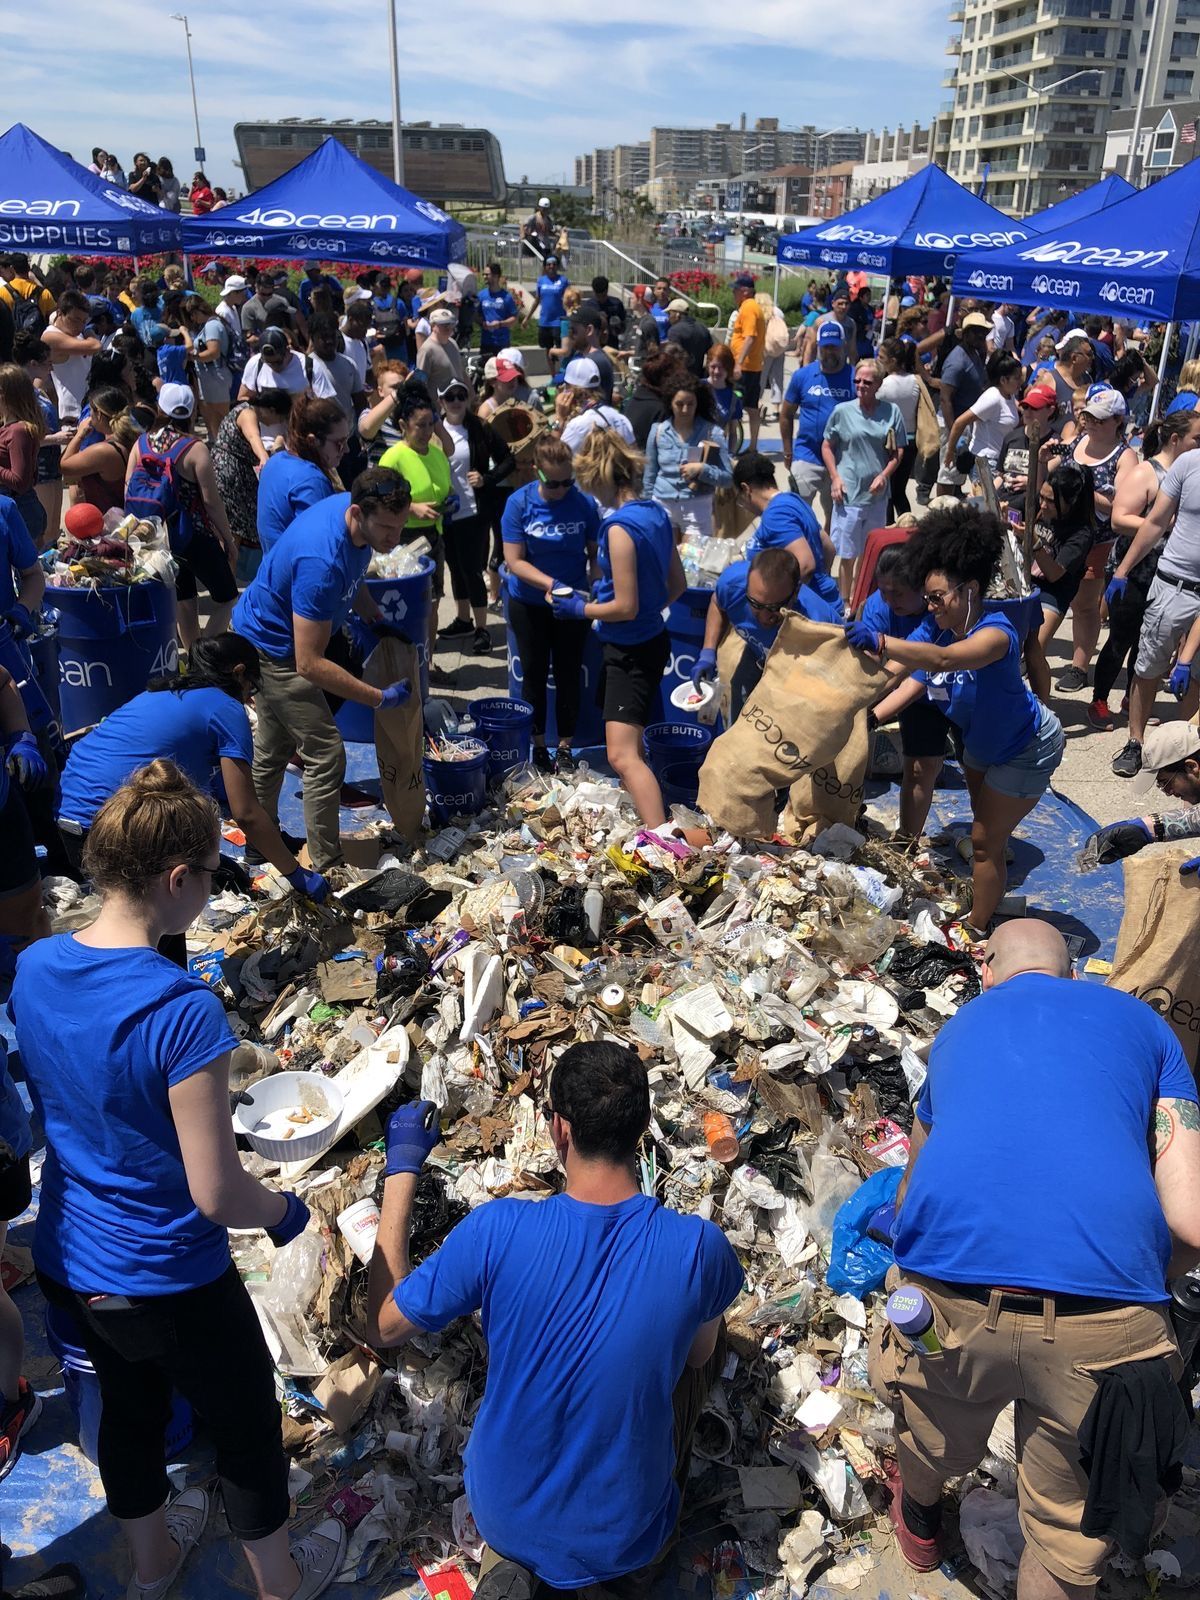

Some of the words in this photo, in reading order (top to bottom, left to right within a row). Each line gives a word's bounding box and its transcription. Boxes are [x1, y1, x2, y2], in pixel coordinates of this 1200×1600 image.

[0, 224, 112, 247] SUPPLIES
[671, 725, 703, 738] BUTTS
[893, 1295, 918, 1306] SPACE
[892, 1303, 910, 1311] NEED
